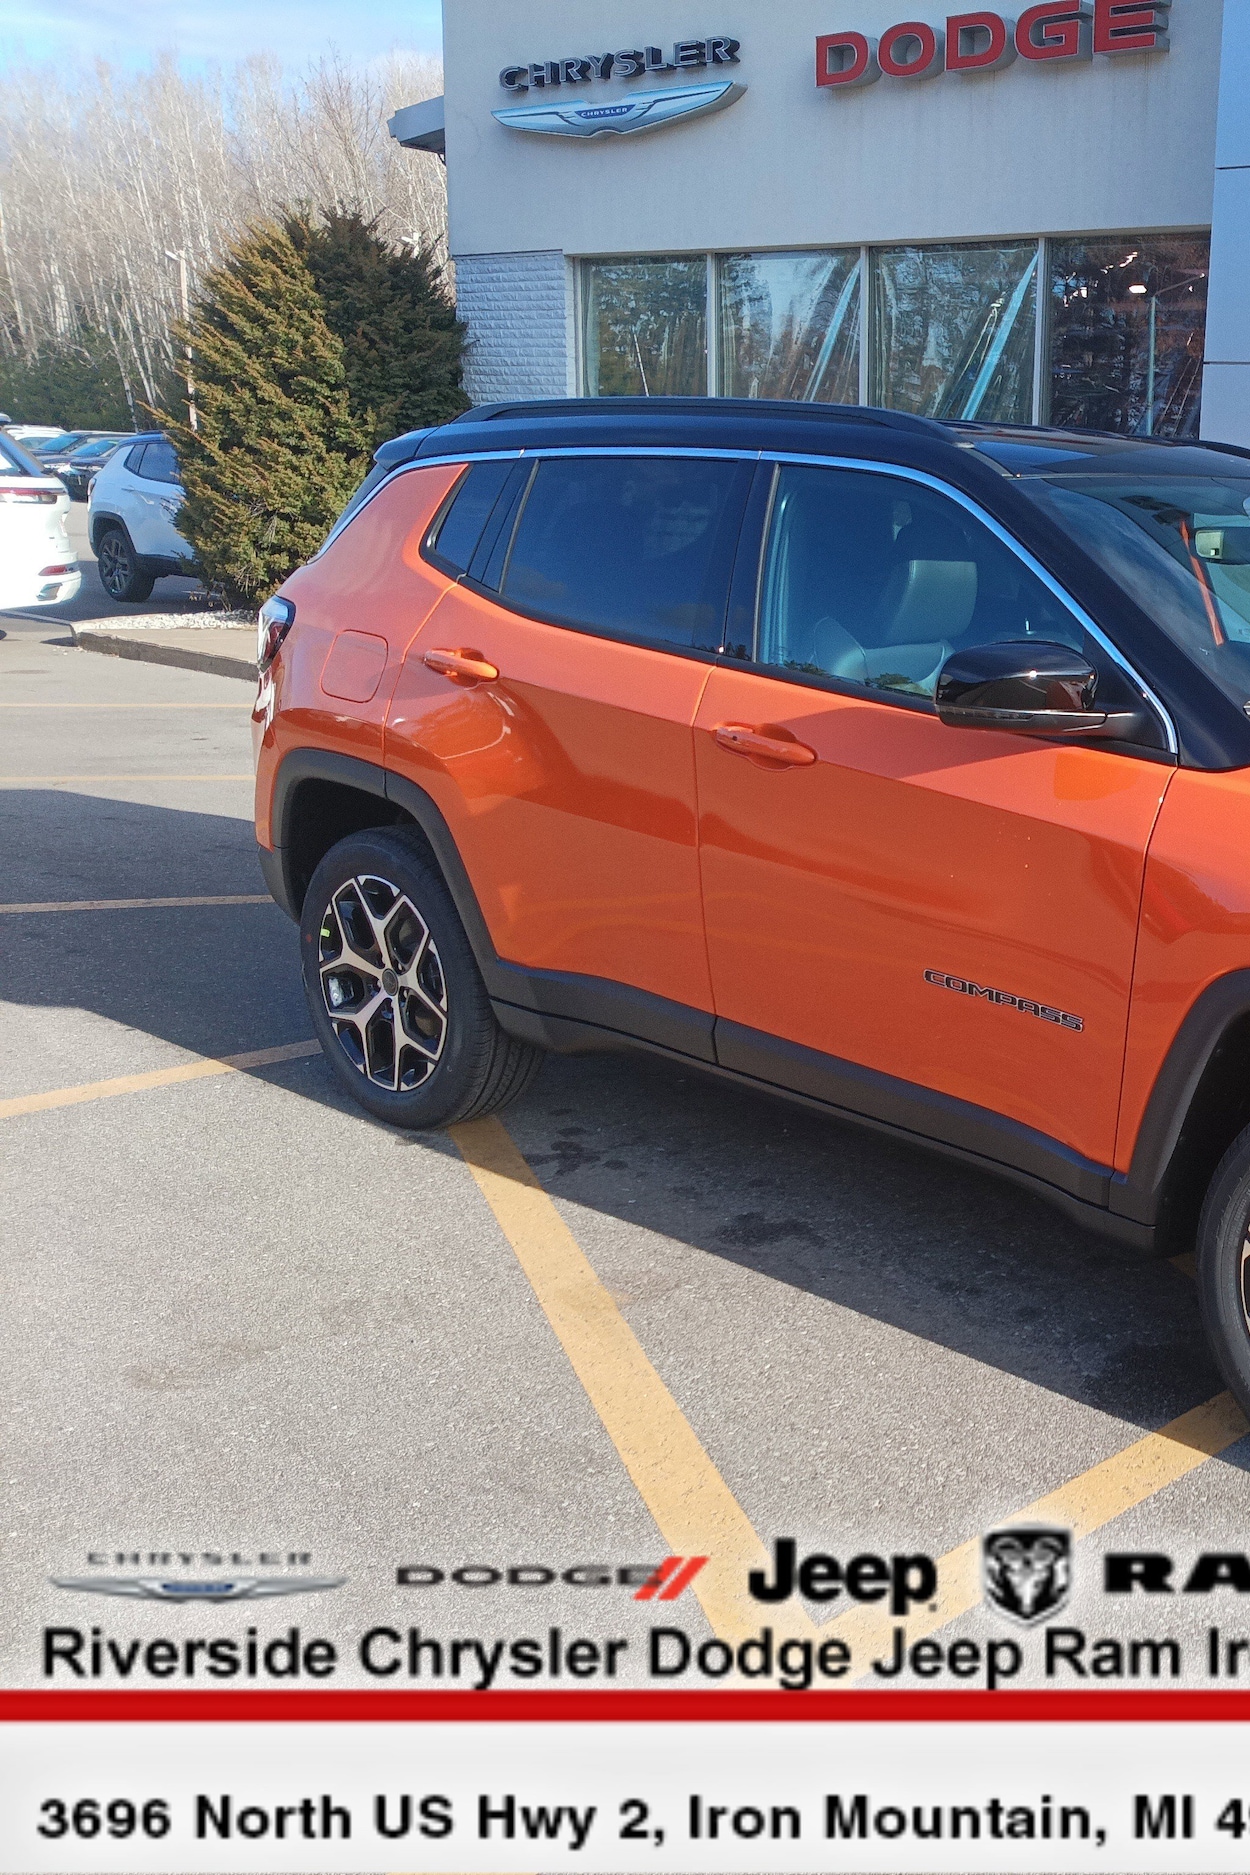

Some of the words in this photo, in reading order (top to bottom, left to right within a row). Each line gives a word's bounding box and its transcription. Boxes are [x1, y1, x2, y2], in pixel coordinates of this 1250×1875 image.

[499, 36, 739, 92] CHRYSLER
[815, 0, 1167, 88] DODGE
[581, 107, 628, 117] CHRYSLER
[923, 968, 1083, 1033] COMPASS
